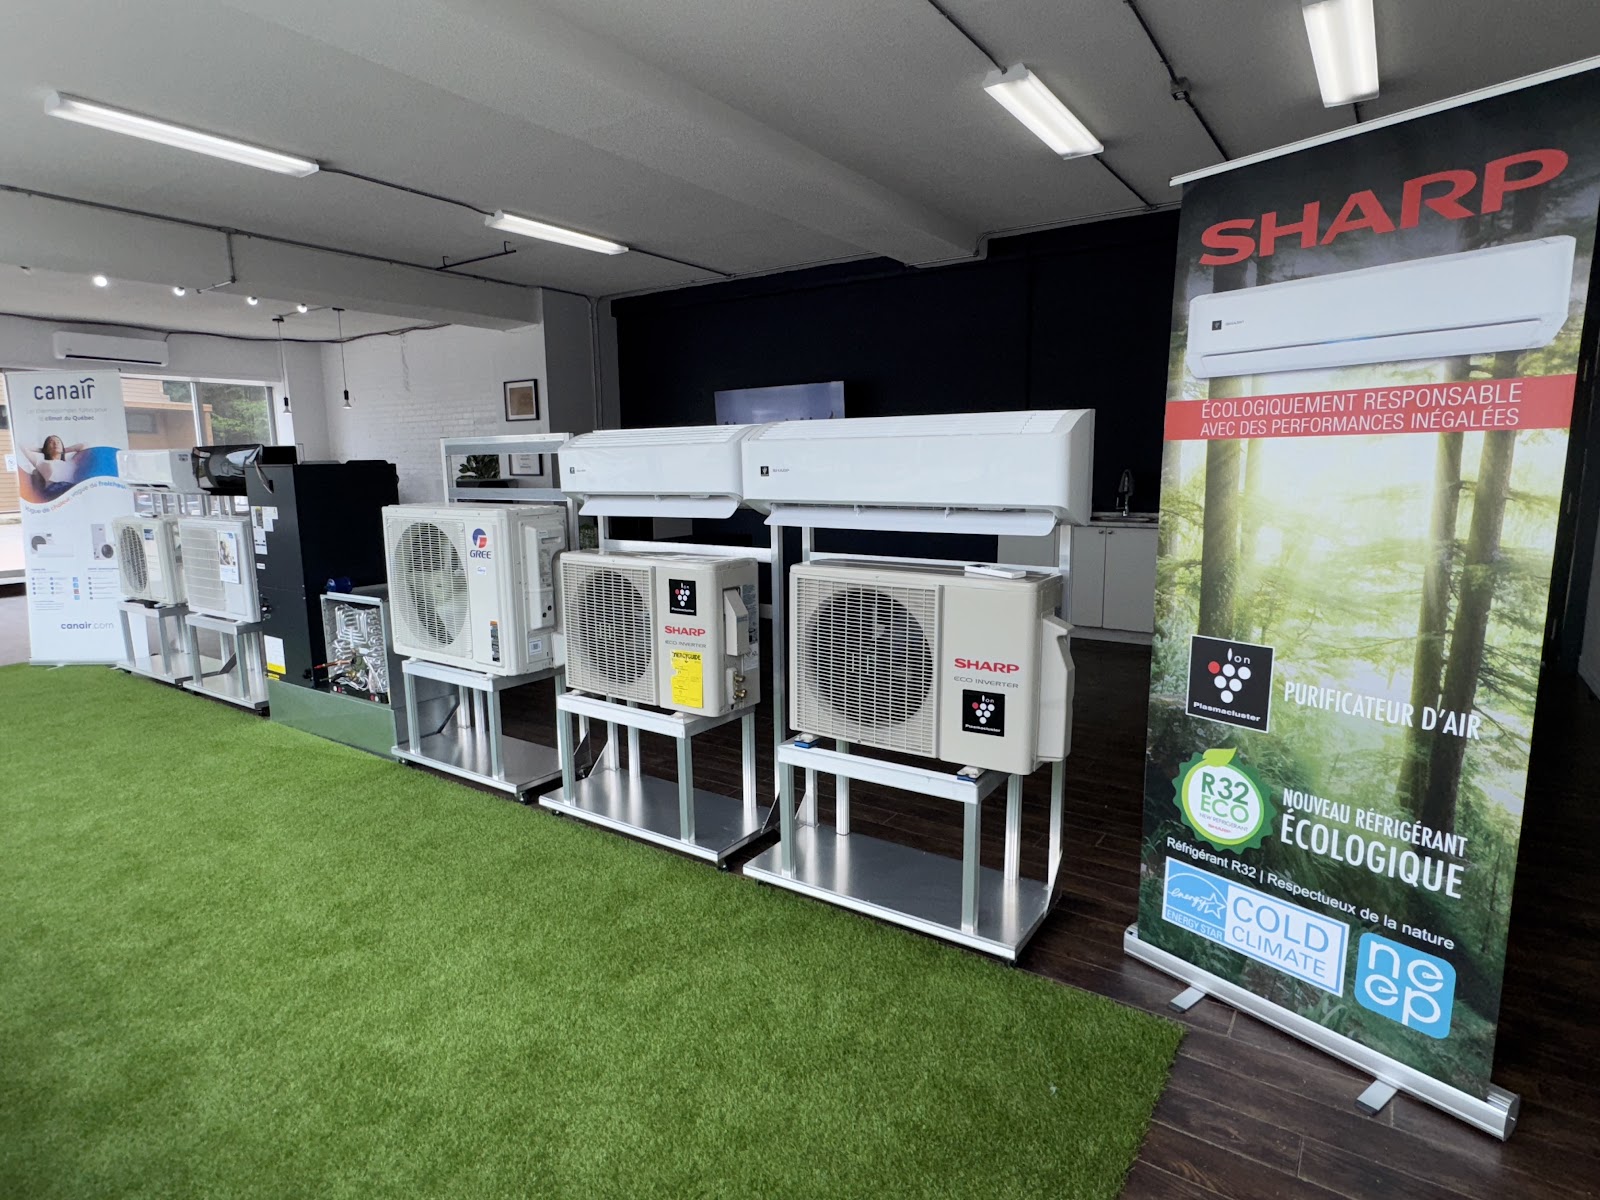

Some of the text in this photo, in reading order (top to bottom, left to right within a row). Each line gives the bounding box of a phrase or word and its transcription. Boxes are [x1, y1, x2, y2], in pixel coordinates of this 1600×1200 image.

[1199, 149, 1569, 266] SHARP
[34, 378, 95, 400] canair
[1202, 382, 1524, 419] ÉCOLOGIQUEMENT RESPONSABLE
[1200, 406, 1519, 437] AVEC DES PERFORMANCES INÉGALÉES
[469, 549, 492, 560] GREE
[60, 621, 114, 630] canair.com
[665, 625, 706, 636] SHARP
[954, 658, 1020, 673] SHARP
[1227, 647, 1252, 664] Ion
[975, 679, 1019, 688] INVERTER
[1193, 701, 1261, 722] Plasmacluster
[1284, 680, 1482, 740] PURIFICATEUR D'AIR
[1201, 771, 1250, 807] R32
[1200, 793, 1250, 824] ECO
[1283, 787, 1468, 858] NOUVEAU RÉFRIGÉRANT
[1280, 807, 1465, 900] ÉCOLOGIQUE
[1166, 836, 1229, 868] Réfrigérant
[1231, 860, 1257, 879] R32
[1267, 873, 1357, 915] Respectueux
[1360, 907, 1379, 923] de
[1383, 914, 1397, 930] la
[1401, 923, 1455, 950] nature
[1167, 909, 1223, 941] ENERGY STAR
[1233, 896, 1329, 953] COLD
[1232, 925, 1326, 979] CLIMATE
